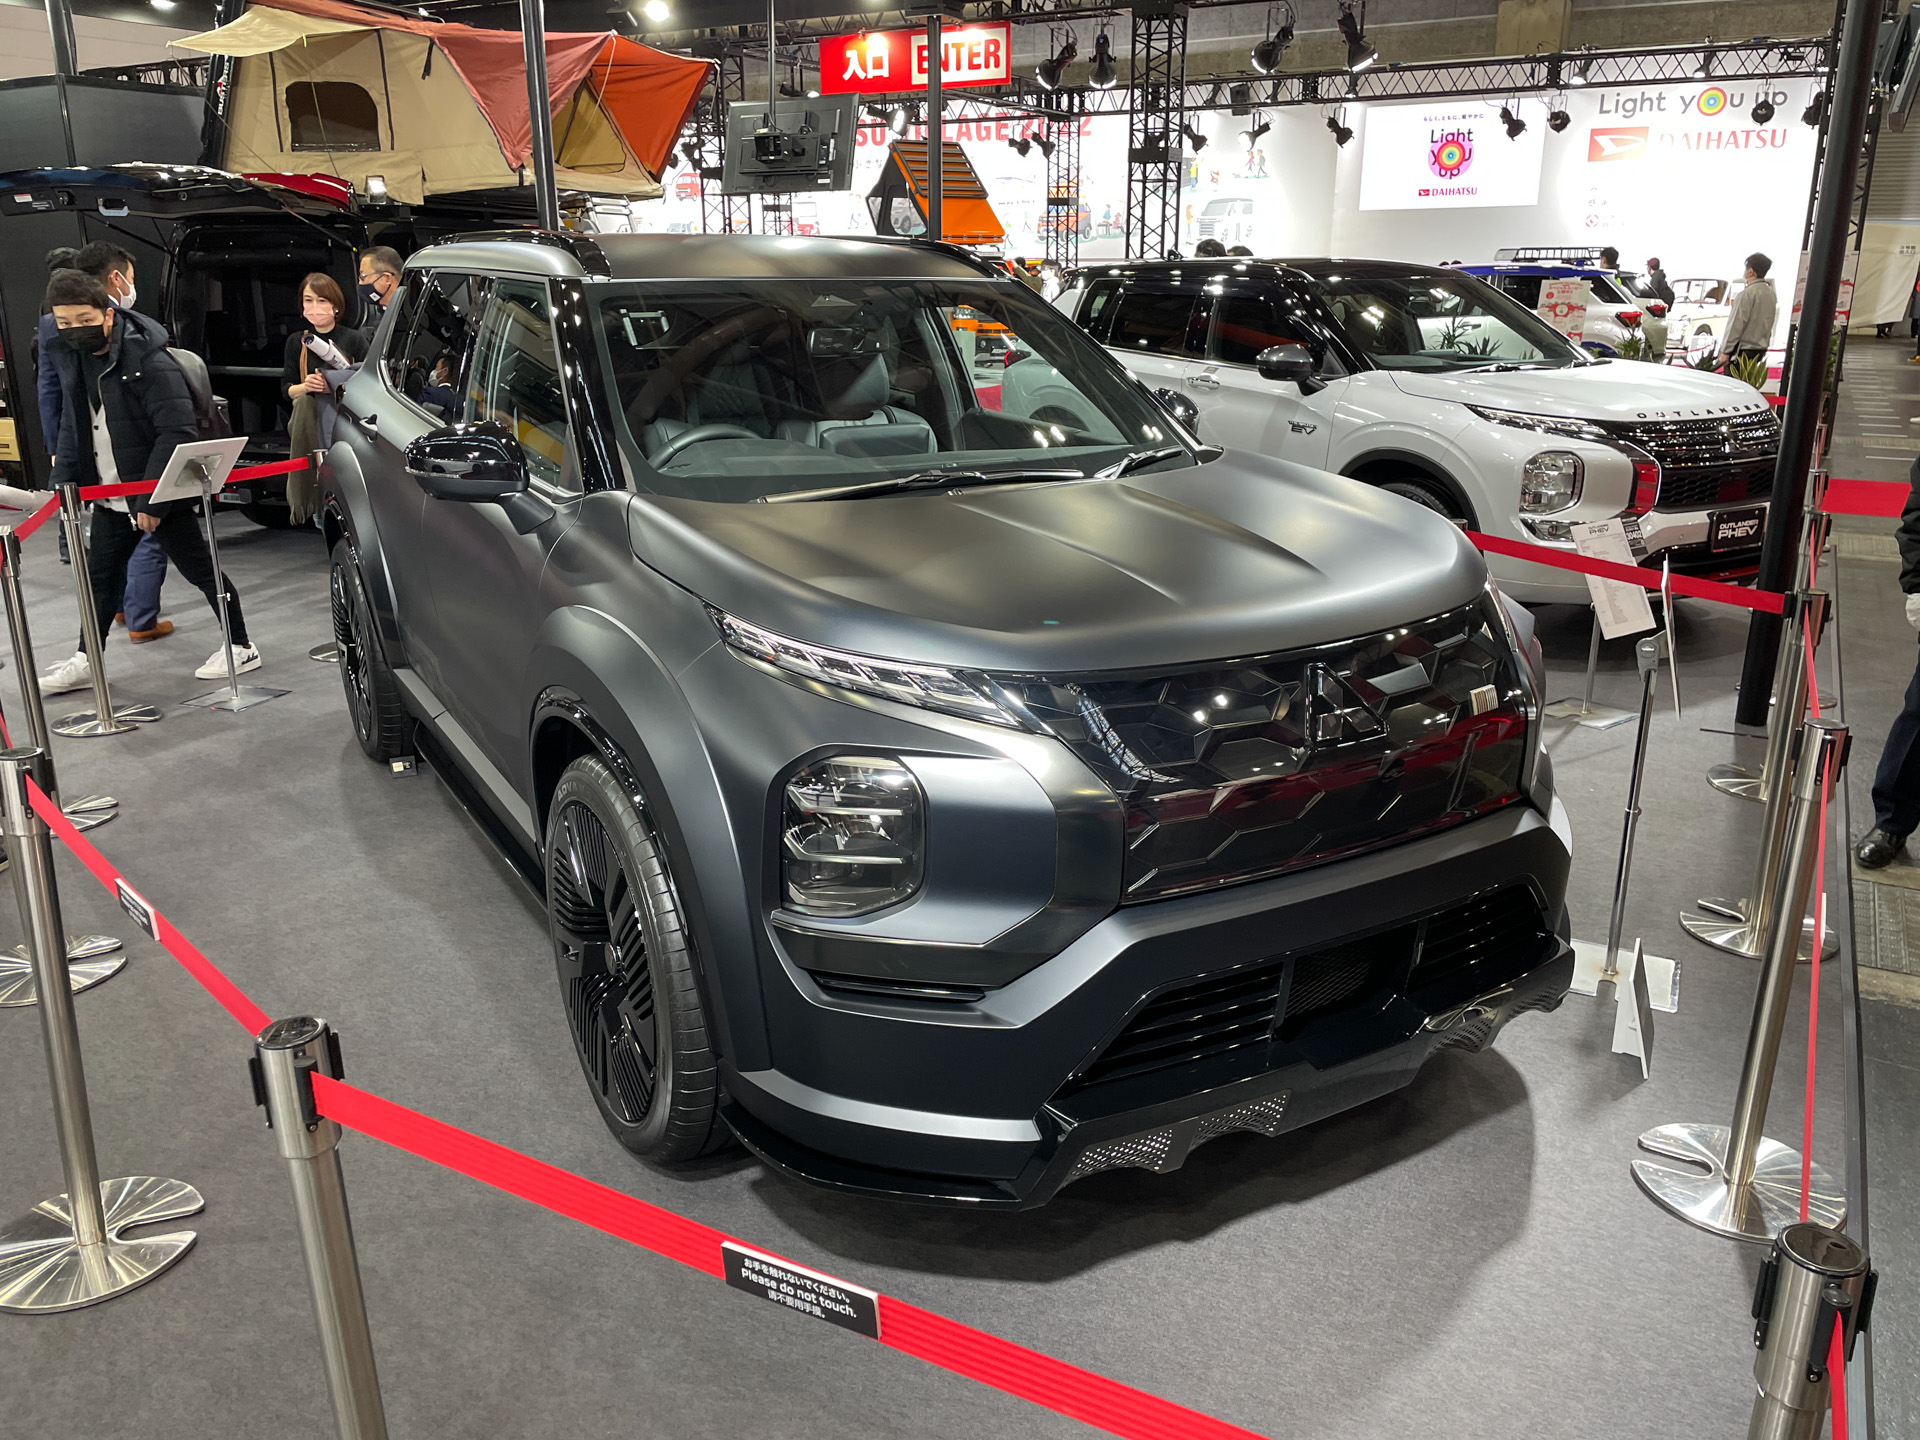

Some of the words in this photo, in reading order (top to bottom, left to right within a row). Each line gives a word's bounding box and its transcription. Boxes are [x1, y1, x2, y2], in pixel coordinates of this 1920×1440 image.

[842, 48, 889, 81] 入口
[1598, 91, 1667, 119] Light
[1430, 128, 1474, 144] Light
[1659, 128, 1788, 151] DAIHATSU
[1431, 187, 1478, 197] DAIHATSU
[1636, 403, 1762, 419] OUTLANDER
[1717, 525, 1758, 540] PHEV
[1719, 519, 1759, 530] OUTLANDER
[744, 1257, 850, 1304] お手を触れないでください。
[741, 1267, 777, 1290] Please
[779, 1282, 795, 1295] do
[796, 1289, 817, 1304] not
[819, 1296, 857, 1318] touch.
